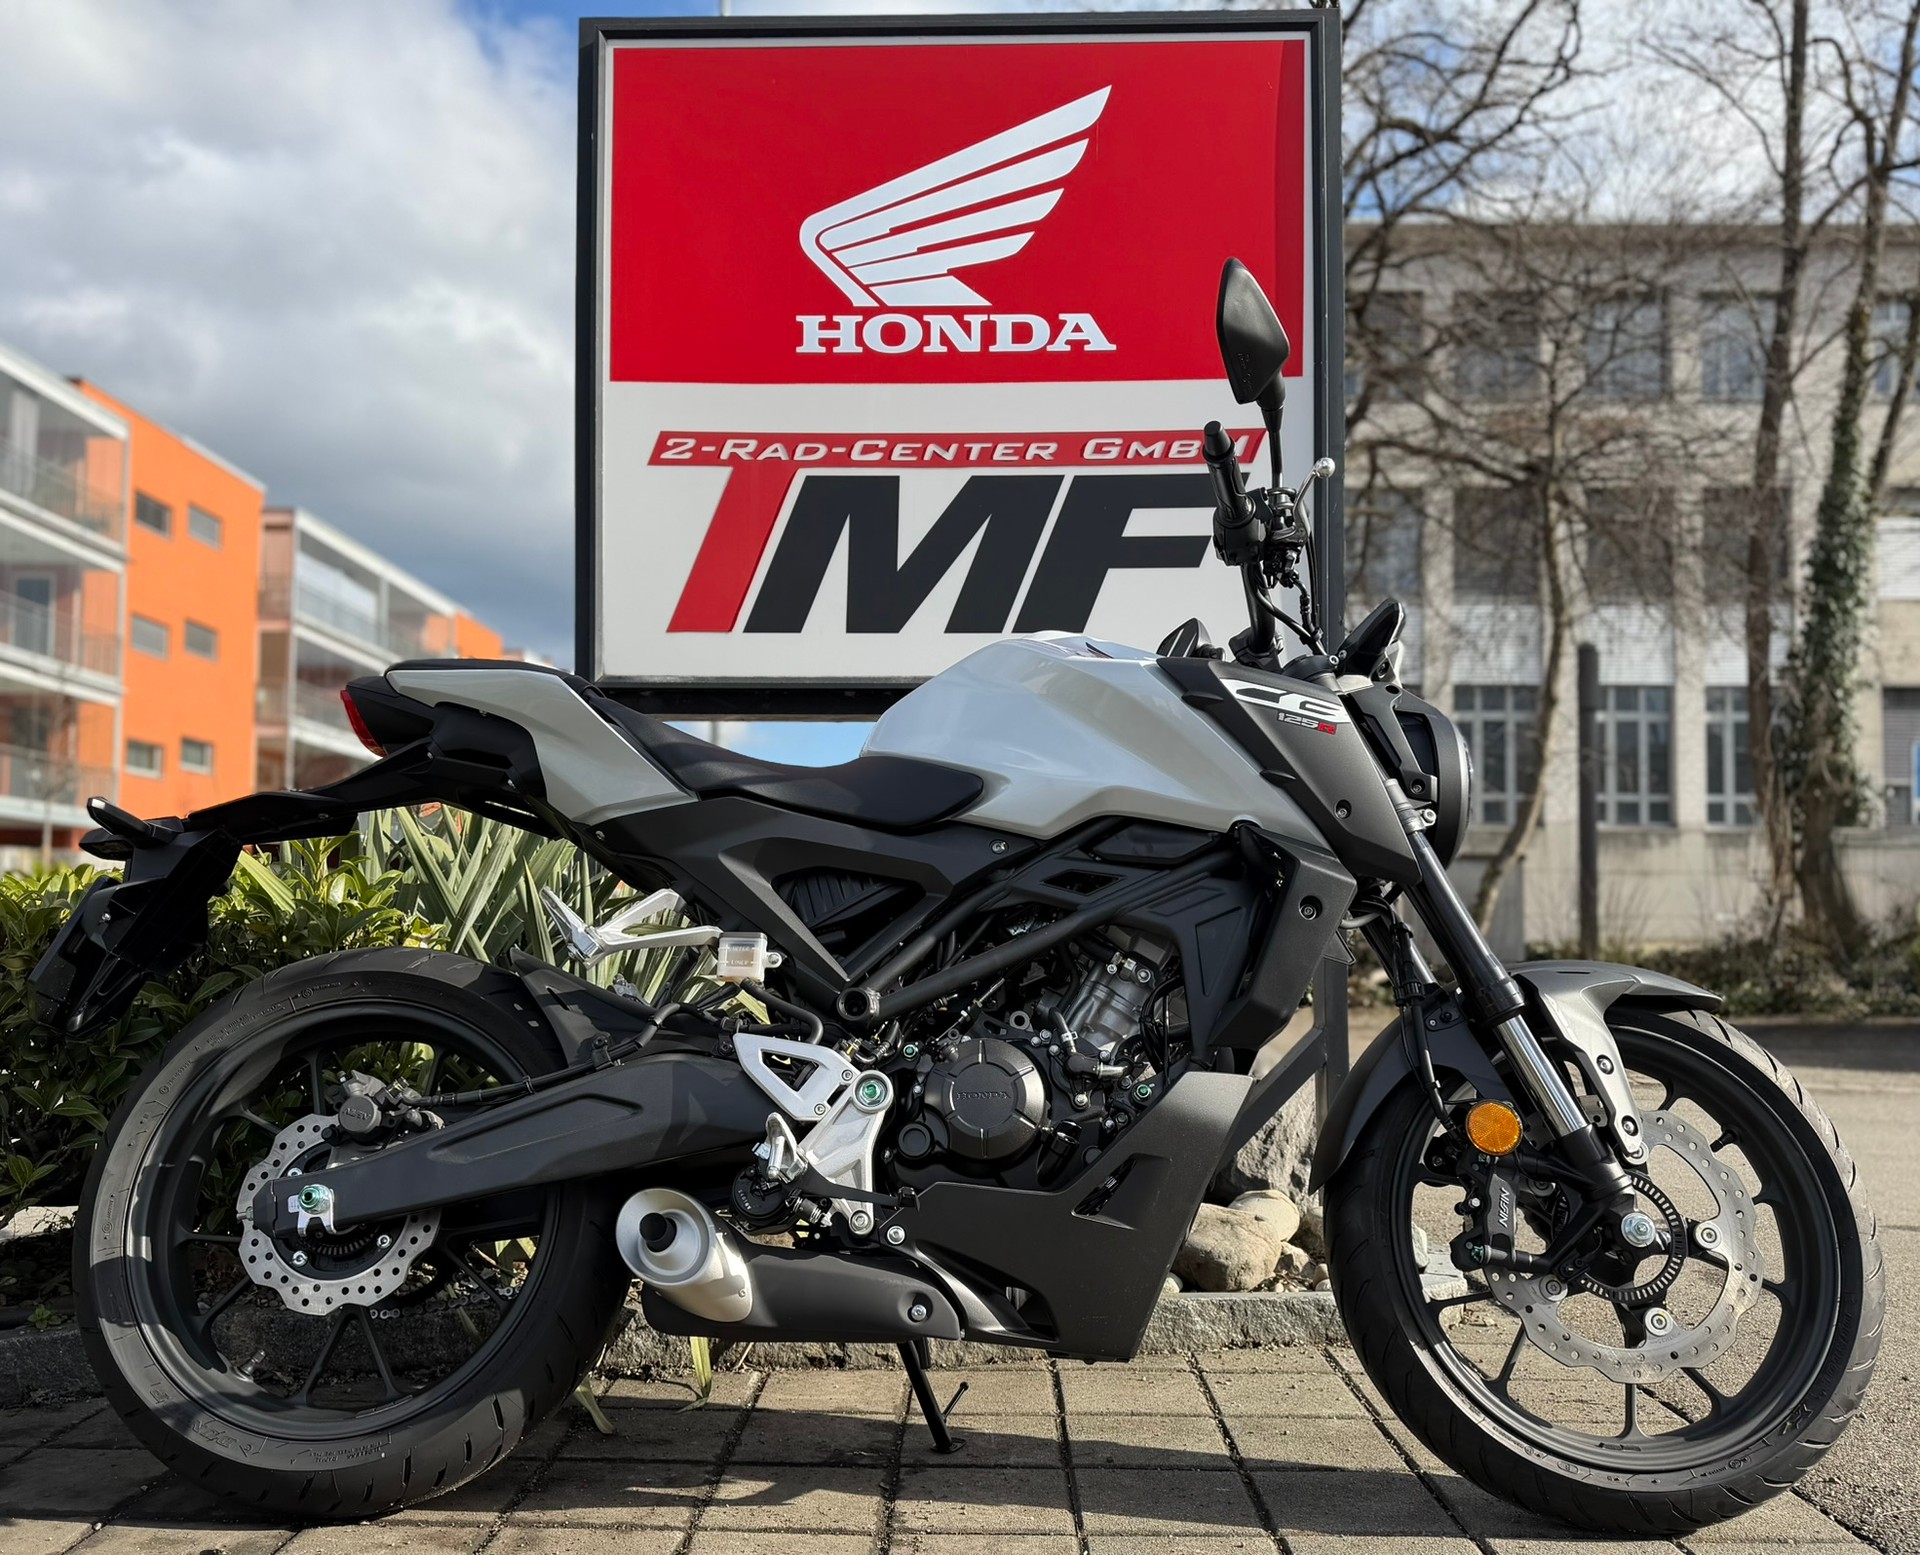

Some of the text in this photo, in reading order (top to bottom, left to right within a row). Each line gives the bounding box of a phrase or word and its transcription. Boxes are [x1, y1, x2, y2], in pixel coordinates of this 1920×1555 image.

[795, 312, 1117, 354] HONDA
[655, 458, 1250, 635] TMF
[1278, 711, 1338, 736] 125R
[956, 1091, 1011, 1101] HONDA
